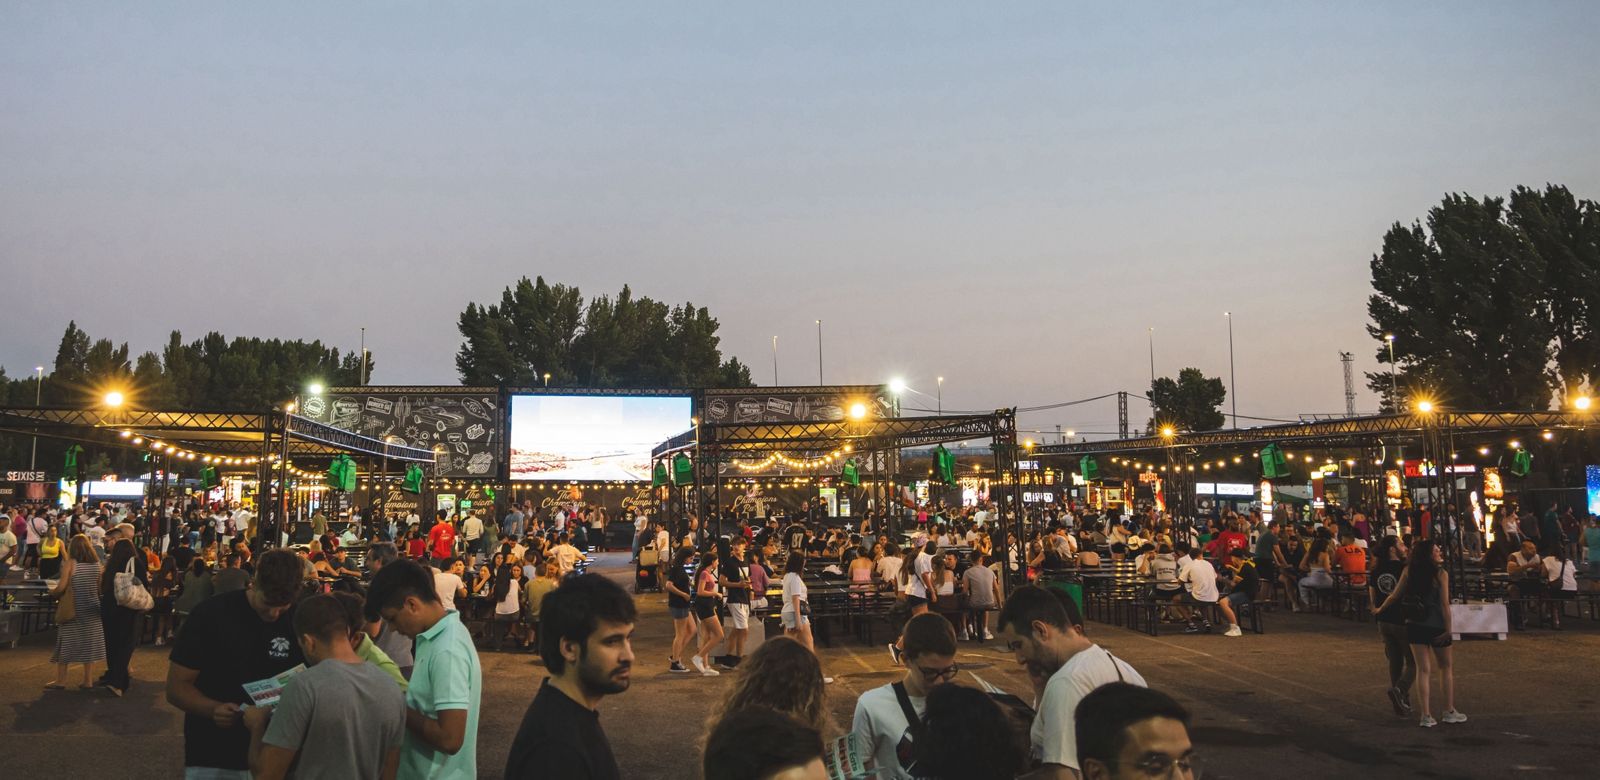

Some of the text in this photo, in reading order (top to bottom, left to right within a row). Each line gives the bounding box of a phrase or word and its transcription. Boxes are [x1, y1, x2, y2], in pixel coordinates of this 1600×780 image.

[7, 471, 35, 481] SEIXIS
[389, 490, 404, 501] The
[465, 489, 479, 500] The
[636, 489, 651, 500] The
[792, 533, 803, 548] 87
